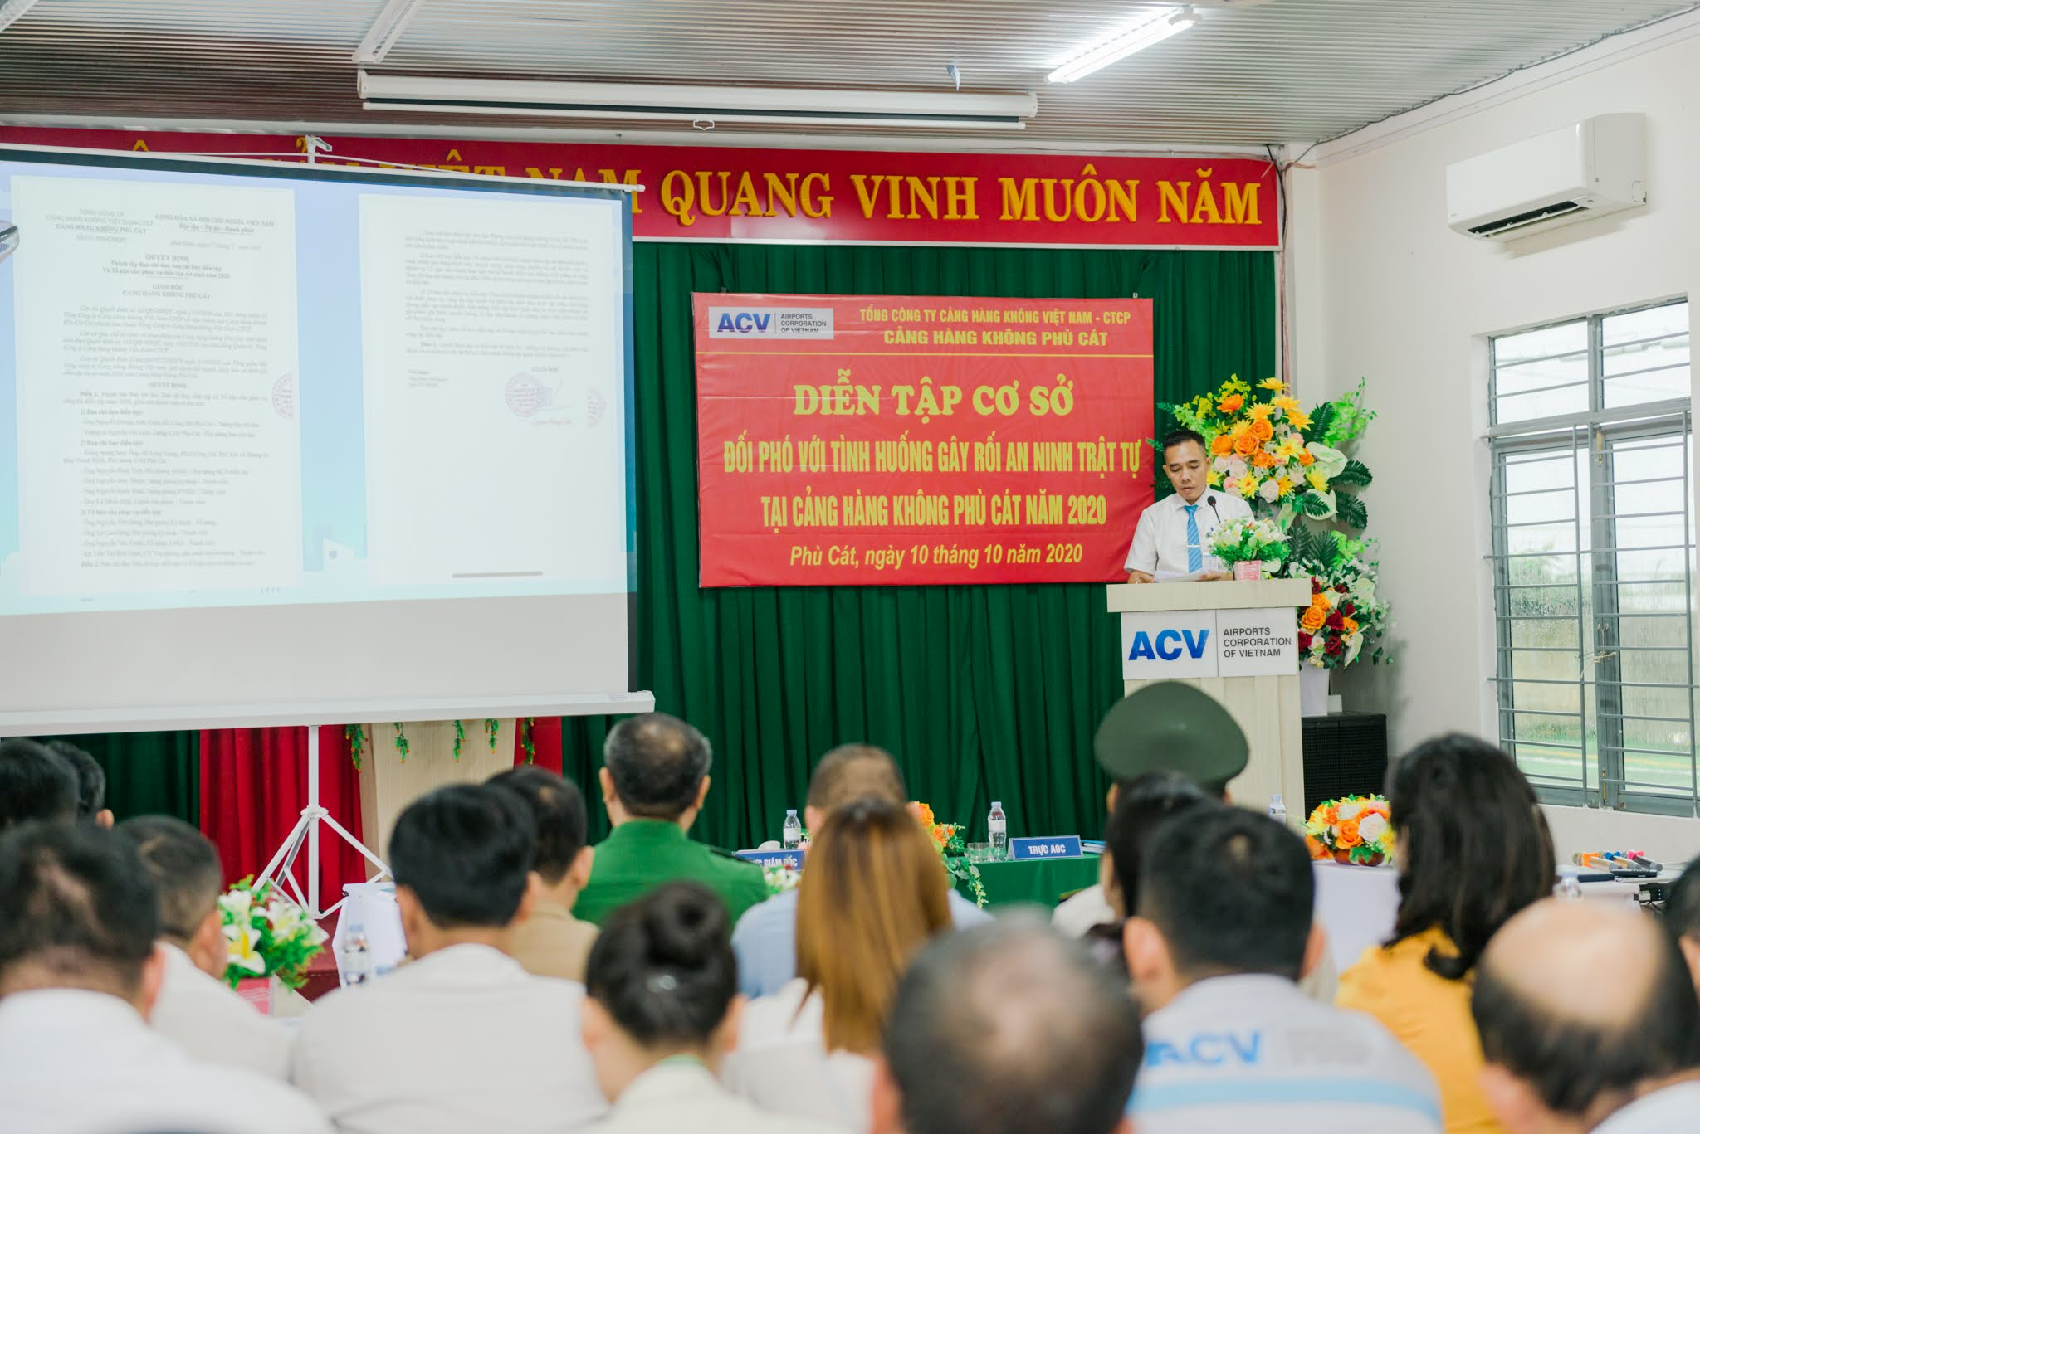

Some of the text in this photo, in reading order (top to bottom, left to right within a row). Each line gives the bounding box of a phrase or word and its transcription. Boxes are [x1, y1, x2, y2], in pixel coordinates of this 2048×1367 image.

[661, 170, 834, 227] QUANG
[850, 174, 980, 221] VINH
[999, 163, 1139, 223] MUÔN
[1156, 167, 1263, 226] NĂM
[717, 313, 770, 333] ACV
[860, 304, 888, 322] TỔNG
[892, 307, 921, 322] CÔNG
[924, 309, 936, 322] TY
[971, 307, 1000, 323] HÀNG
[1004, 308, 1039, 323] KHÔNG
[1042, 308, 1066, 326] VIỆT
[1069, 311, 1093, 324] NAM
[1103, 311, 1131, 324] CTCP
[884, 325, 1107, 346] CẢNG HÀNG KHÔNG PHÙ CÁT
[793, 368, 1074, 424] DIỄN TẬP CƠ SỞ
[723, 430, 1142, 479] ĐỐI PHÓ VỚI TÌNH HUỐNG GÂY RỐI AN NINH TRẬT TỰ
[760, 485, 1107, 533] TẠI CẢNG HÀNG KHÔNG PHÙ CÁT NĂM 2020
[790, 543, 1083, 570] Phù Cát, ngày 10 tháng 10 năm 2020
[1223, 627, 1271, 636] AIRPORTS
[1223, 637, 1292, 647] CORPORATION
[1128, 629, 1210, 661] ACV
[1223, 648, 1281, 658] OF VIETNAM
